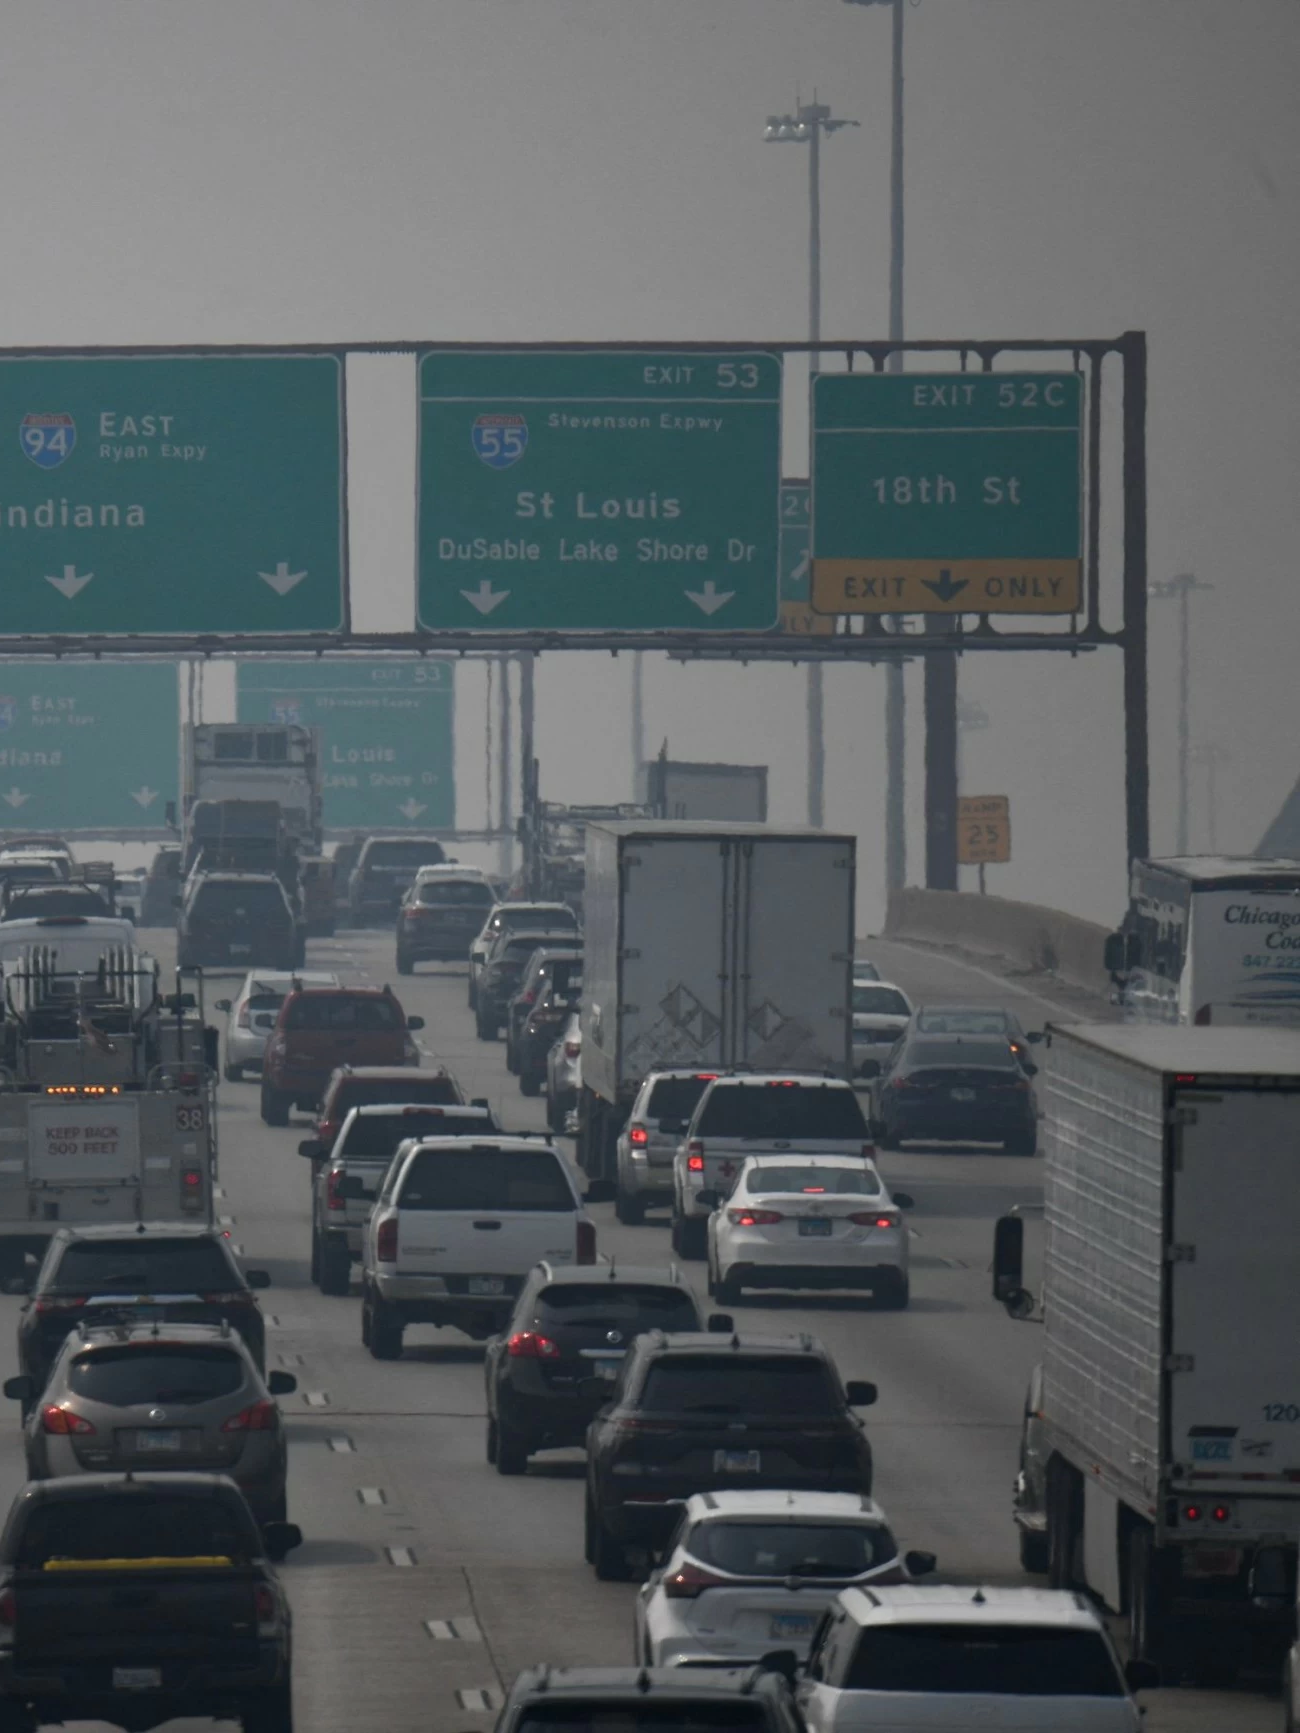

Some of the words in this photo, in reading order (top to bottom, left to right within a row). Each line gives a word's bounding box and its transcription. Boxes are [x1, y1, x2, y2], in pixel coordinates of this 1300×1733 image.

[644, 366, 694, 384] EXIT
[717, 363, 759, 388] 53
[913, 385, 975, 406] EXIT
[997, 382, 1065, 406] 52C
[100, 412, 173, 437] EAST
[548, 413, 650, 429] Stevenson
[660, 413, 723, 432] Expwy
[25, 427, 68, 457] 94
[100, 444, 148, 461] Ryan
[161, 443, 207, 460] Expy
[481, 429, 523, 457] 55
[873, 475, 956, 504] 18th
[983, 476, 1021, 505] St
[516, 492, 553, 519] St
[578, 491, 681, 518] Louis
[439, 538, 540, 560] DuSable
[559, 538, 618, 561] Lake
[637, 538, 708, 561] Shore
[728, 539, 756, 561] Dr
[844, 576, 904, 598] EXIT
[984, 576, 1063, 597] ONLY
[414, 666, 441, 683] 53
[332, 745, 397, 763] Louis
[968, 825, 999, 844] 25
[1225, 903, 1300, 929] Chicago
[177, 1109, 204, 1131] 38
[45, 1127, 80, 1139] KEEP
[84, 1126, 120, 1139] BACK
[47, 1143, 78, 1155] 500
[83, 1142, 119, 1155] FEET
